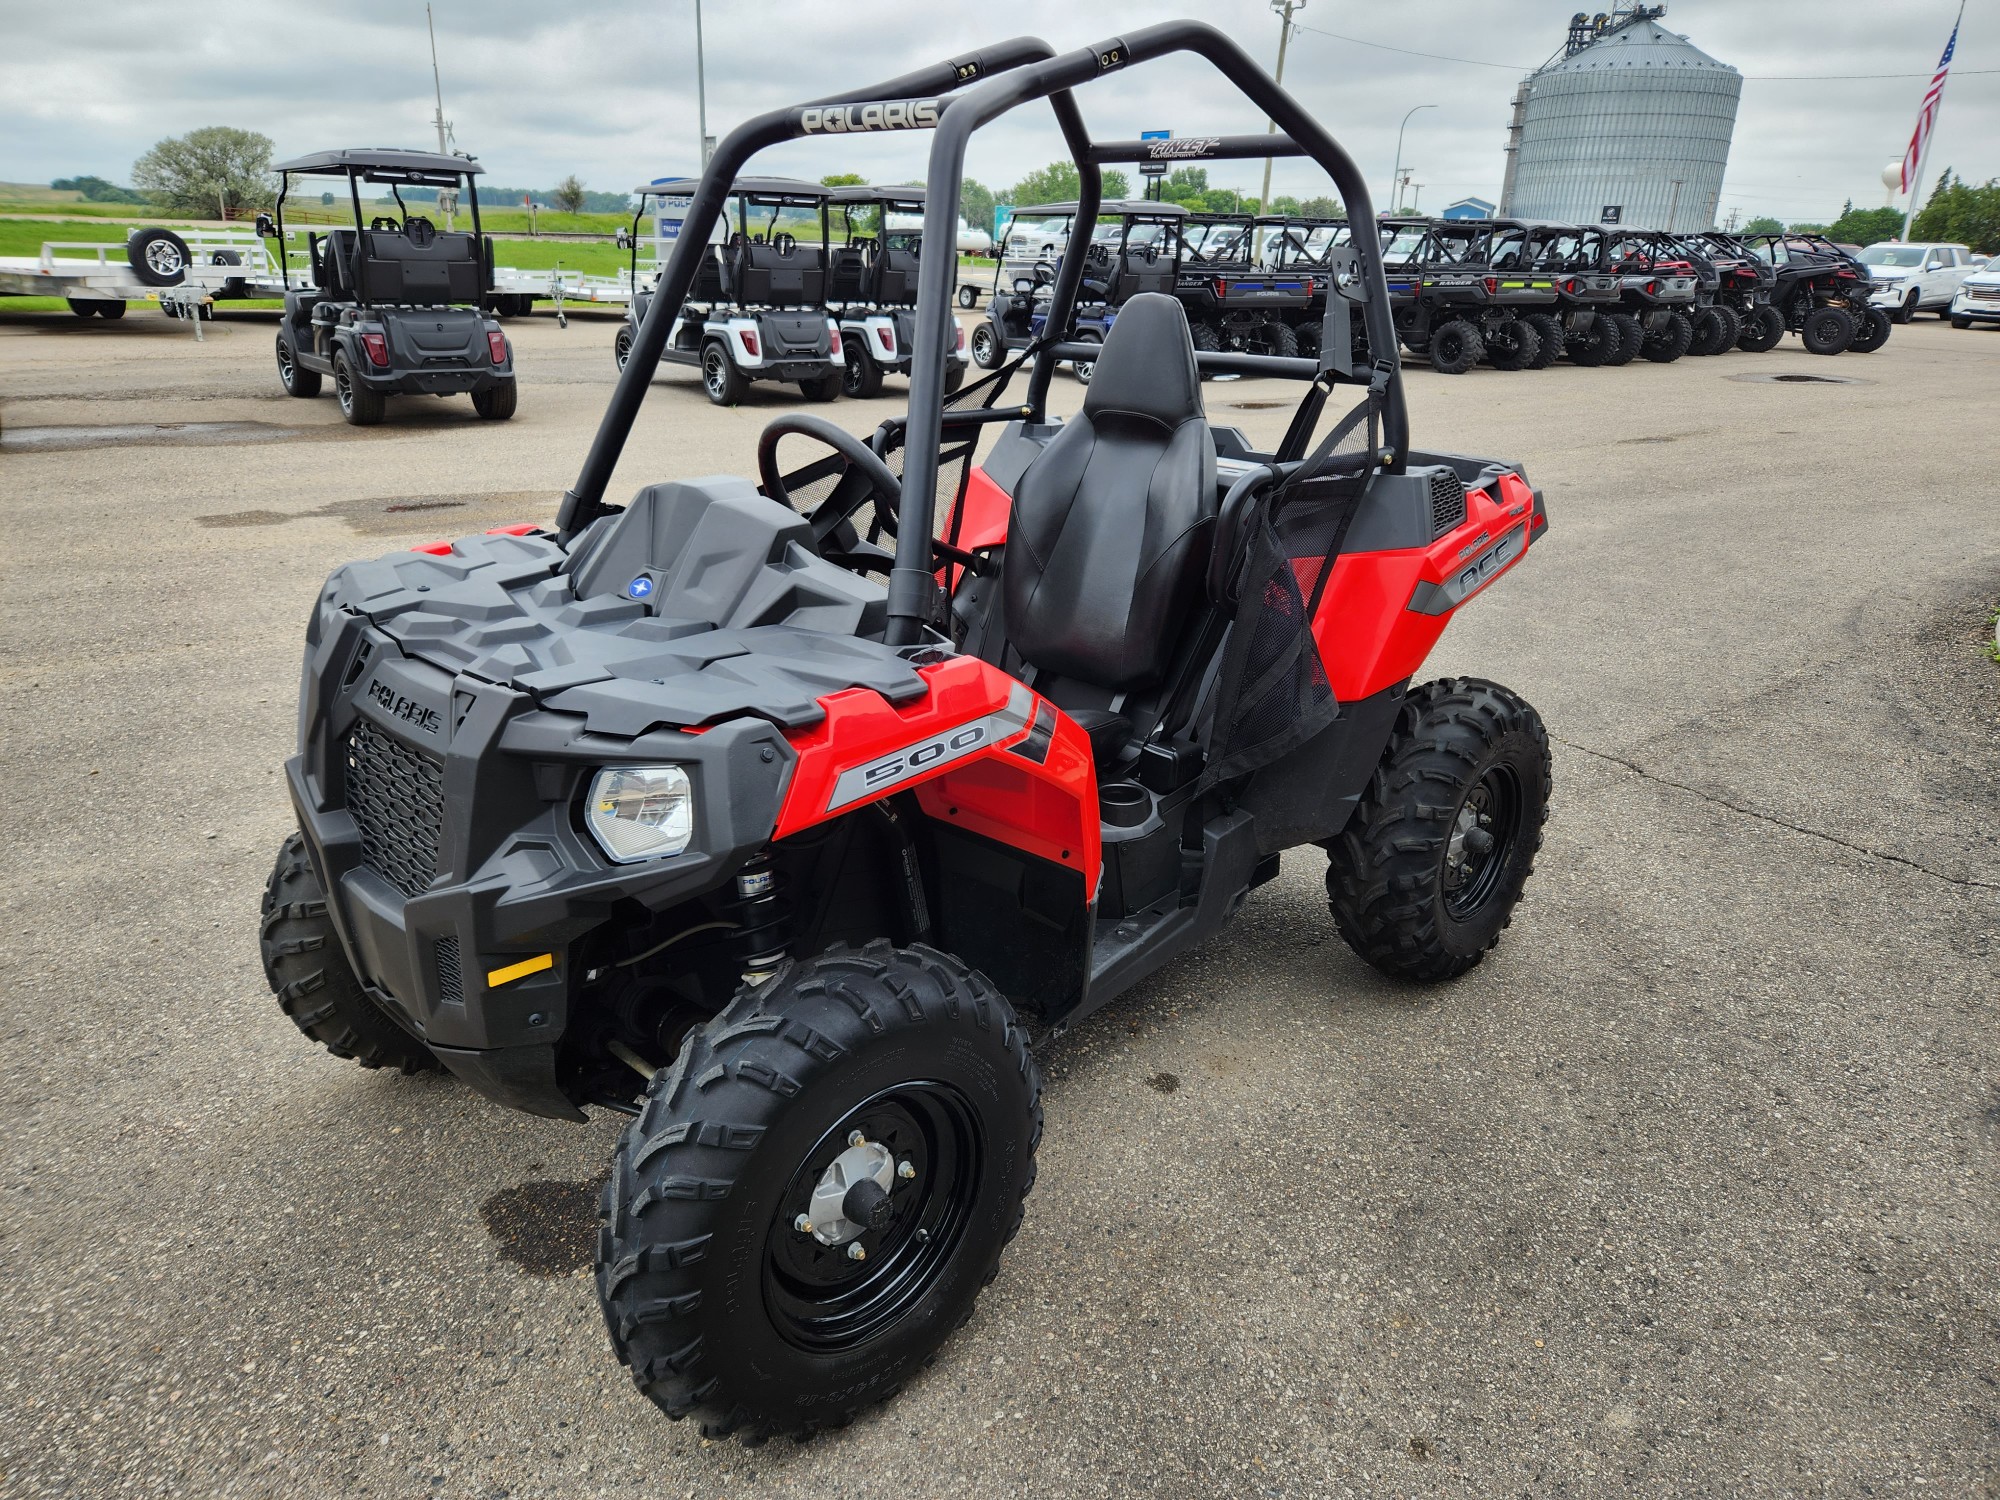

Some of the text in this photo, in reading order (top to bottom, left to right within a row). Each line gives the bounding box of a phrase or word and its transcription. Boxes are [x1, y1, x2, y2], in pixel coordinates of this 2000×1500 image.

[801, 99, 940, 134] POLARIS
[1147, 137, 1220, 154] FINLEY
[1458, 530, 1490, 561] POLARIS
[1458, 536, 1513, 598] ACE
[367, 679, 443, 734] POLARIS
[864, 726, 986, 789] 500
